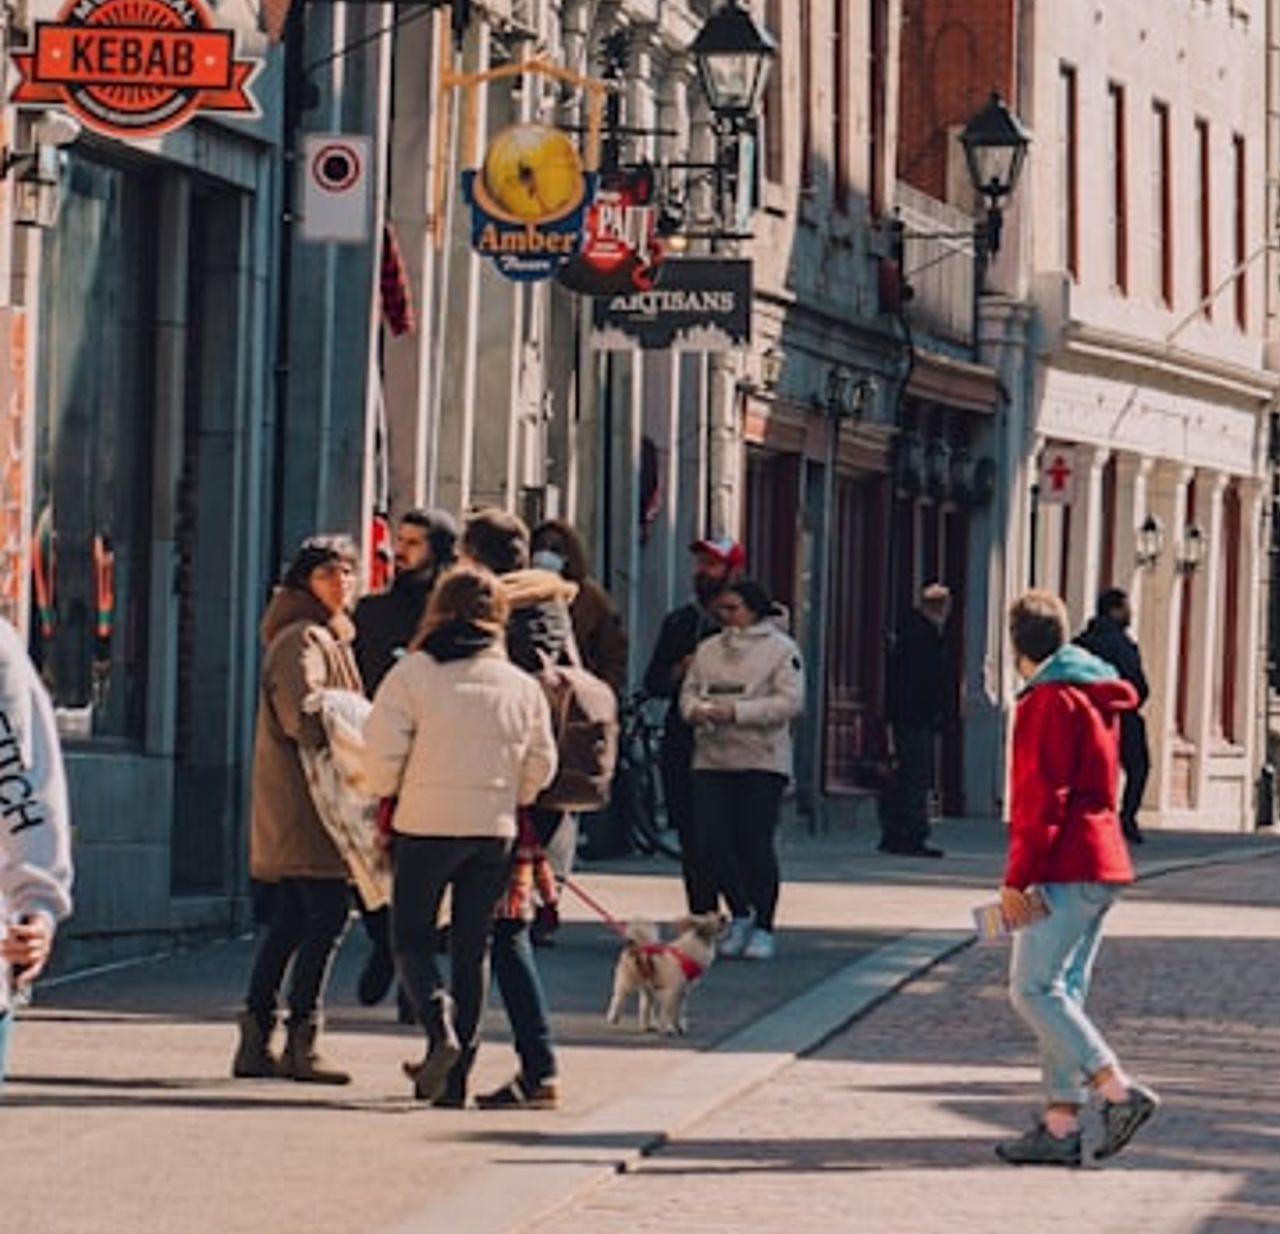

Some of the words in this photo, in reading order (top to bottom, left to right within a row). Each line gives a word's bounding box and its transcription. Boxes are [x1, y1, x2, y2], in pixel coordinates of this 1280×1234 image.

[70, 35, 195, 77] KEBAB
[479, 222, 576, 251] Amber
[596, 201, 652, 266] PAUL
[609, 291, 736, 314] ARTISANS
